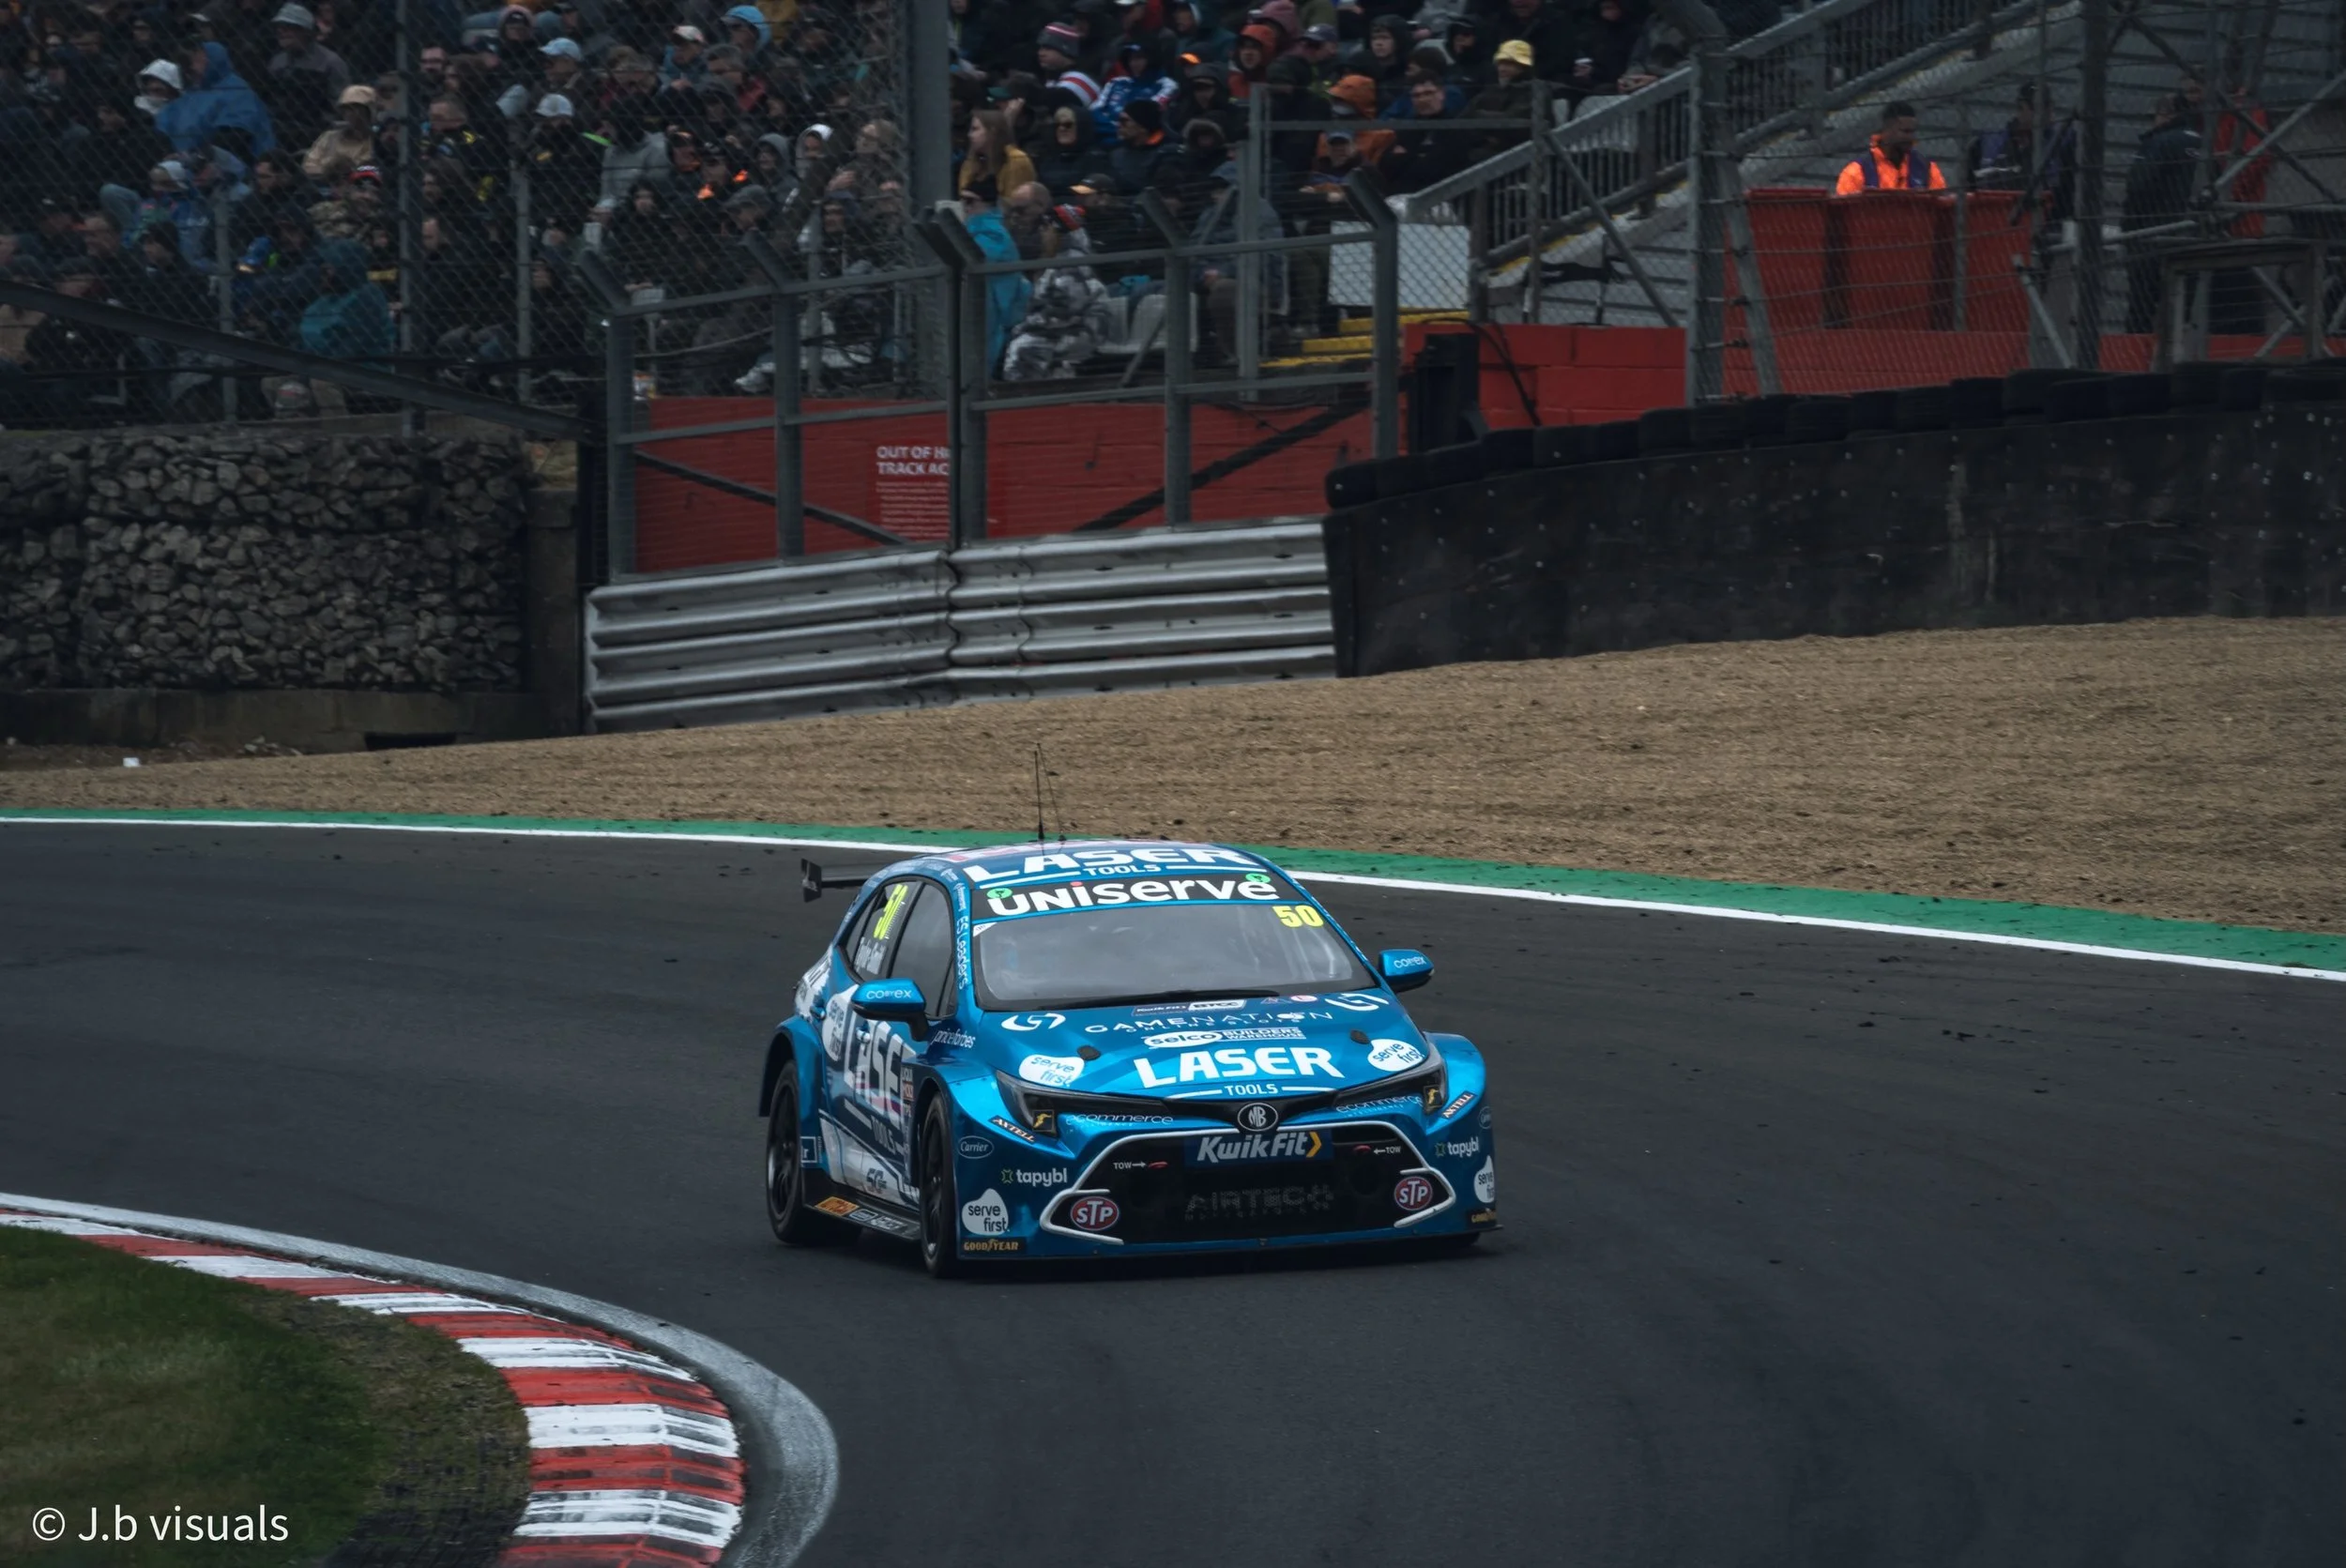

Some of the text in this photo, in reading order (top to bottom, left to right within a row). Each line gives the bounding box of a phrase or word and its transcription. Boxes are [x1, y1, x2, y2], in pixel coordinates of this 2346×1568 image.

[876, 446, 908, 459] OUT
[910, 446, 932, 459] OF
[876, 462, 925, 475] TRACK
[962, 848, 1264, 883] LASER
[1083, 863, 1162, 876] TOOLS
[1272, 905, 1325, 927] 50
[1150, 1034, 1217, 1045] selco
[1372, 1043, 1406, 1062] serve
[1030, 1056, 1075, 1073] serve
[1133, 1046, 1346, 1088] LASER
[1224, 1084, 1279, 1096] TOOLS
[1335, 1095, 1424, 1114] ecommerce
[1442, 1093, 1474, 1119] AXTELL
[1065, 1114, 1175, 1126] ecommerce
[993, 1118, 1035, 1142] AXTELL
[960, 1141, 989, 1153] Carrier
[1385, 1146, 1401, 1154] TOW
[1447, 1136, 1480, 1158] tapybl
[1113, 1162, 1132, 1170] TOW
[1016, 1168, 1068, 1187] tapybl
[1399, 1180, 1429, 1206] STP
[967, 1203, 1001, 1217] serve
[1076, 1200, 1114, 1226] STP
